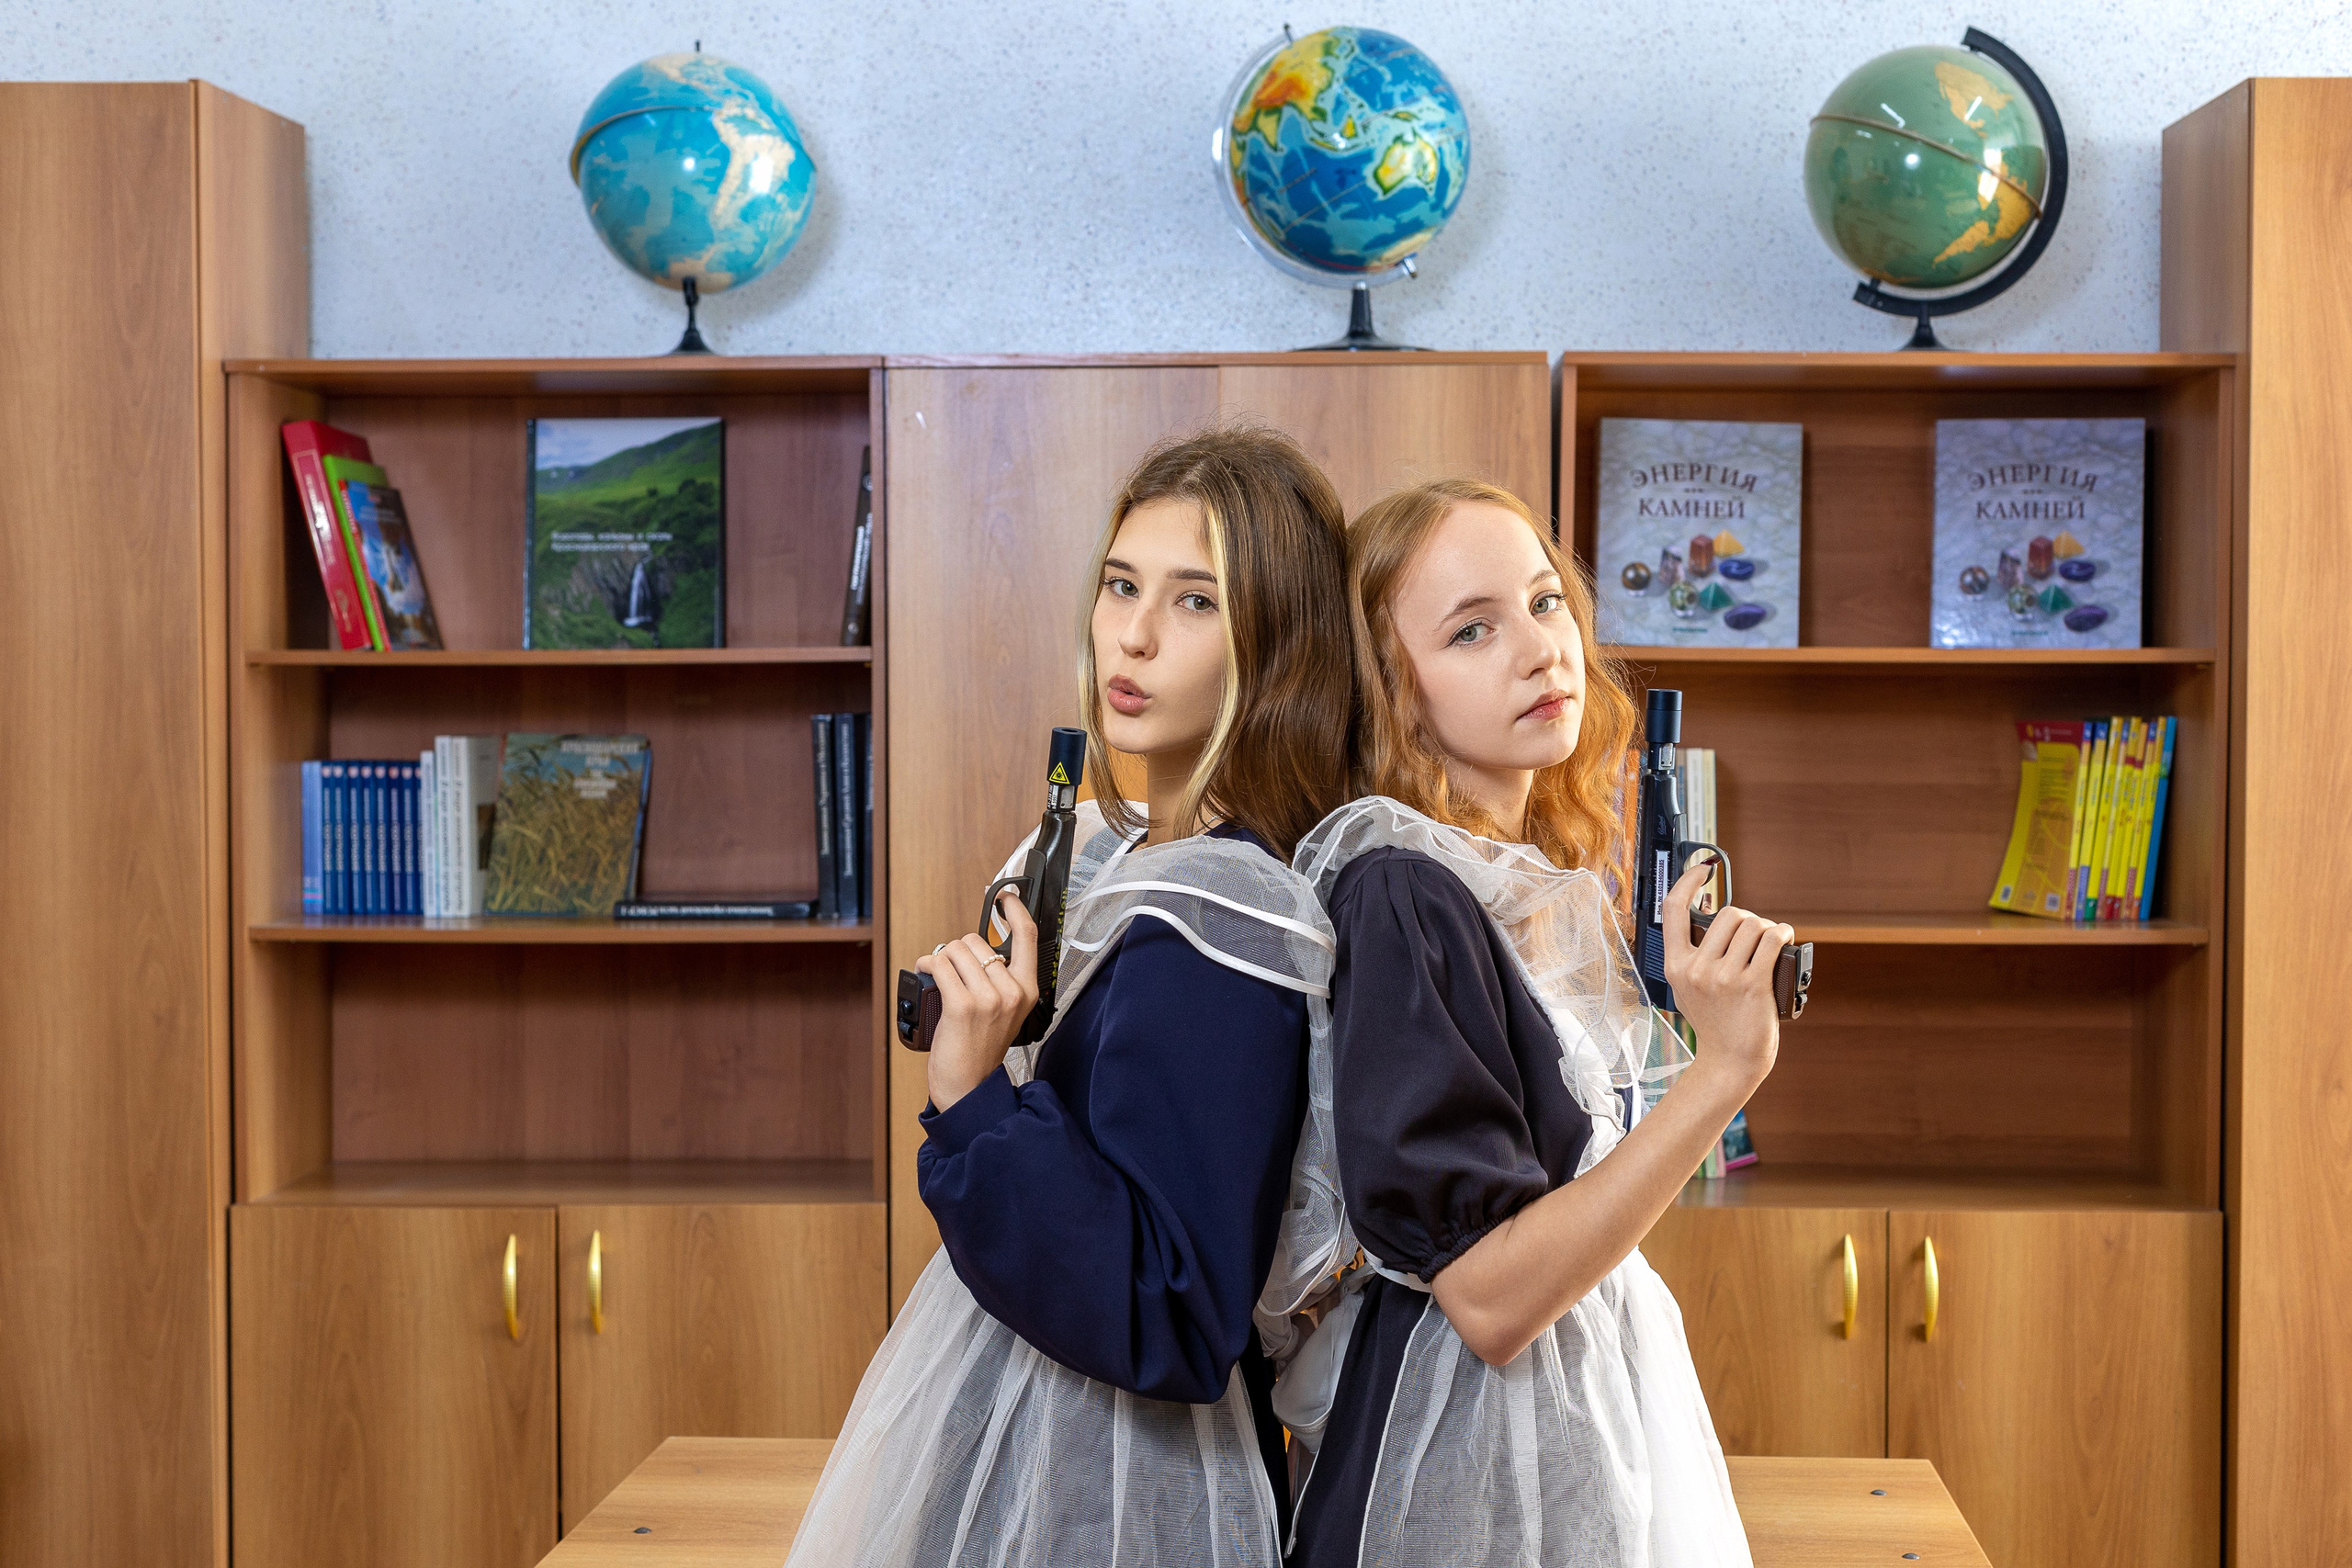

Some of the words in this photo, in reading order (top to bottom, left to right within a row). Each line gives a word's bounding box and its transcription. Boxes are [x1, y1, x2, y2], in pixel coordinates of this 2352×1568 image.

[1630, 462, 1758, 493] ЭНЕРГИЯ
[1967, 462, 2098, 493] ЭНЕРГИЯ
[1639, 495, 1745, 519] КАМНЕЙ
[1976, 496, 2085, 520] КАМНЕЙ
